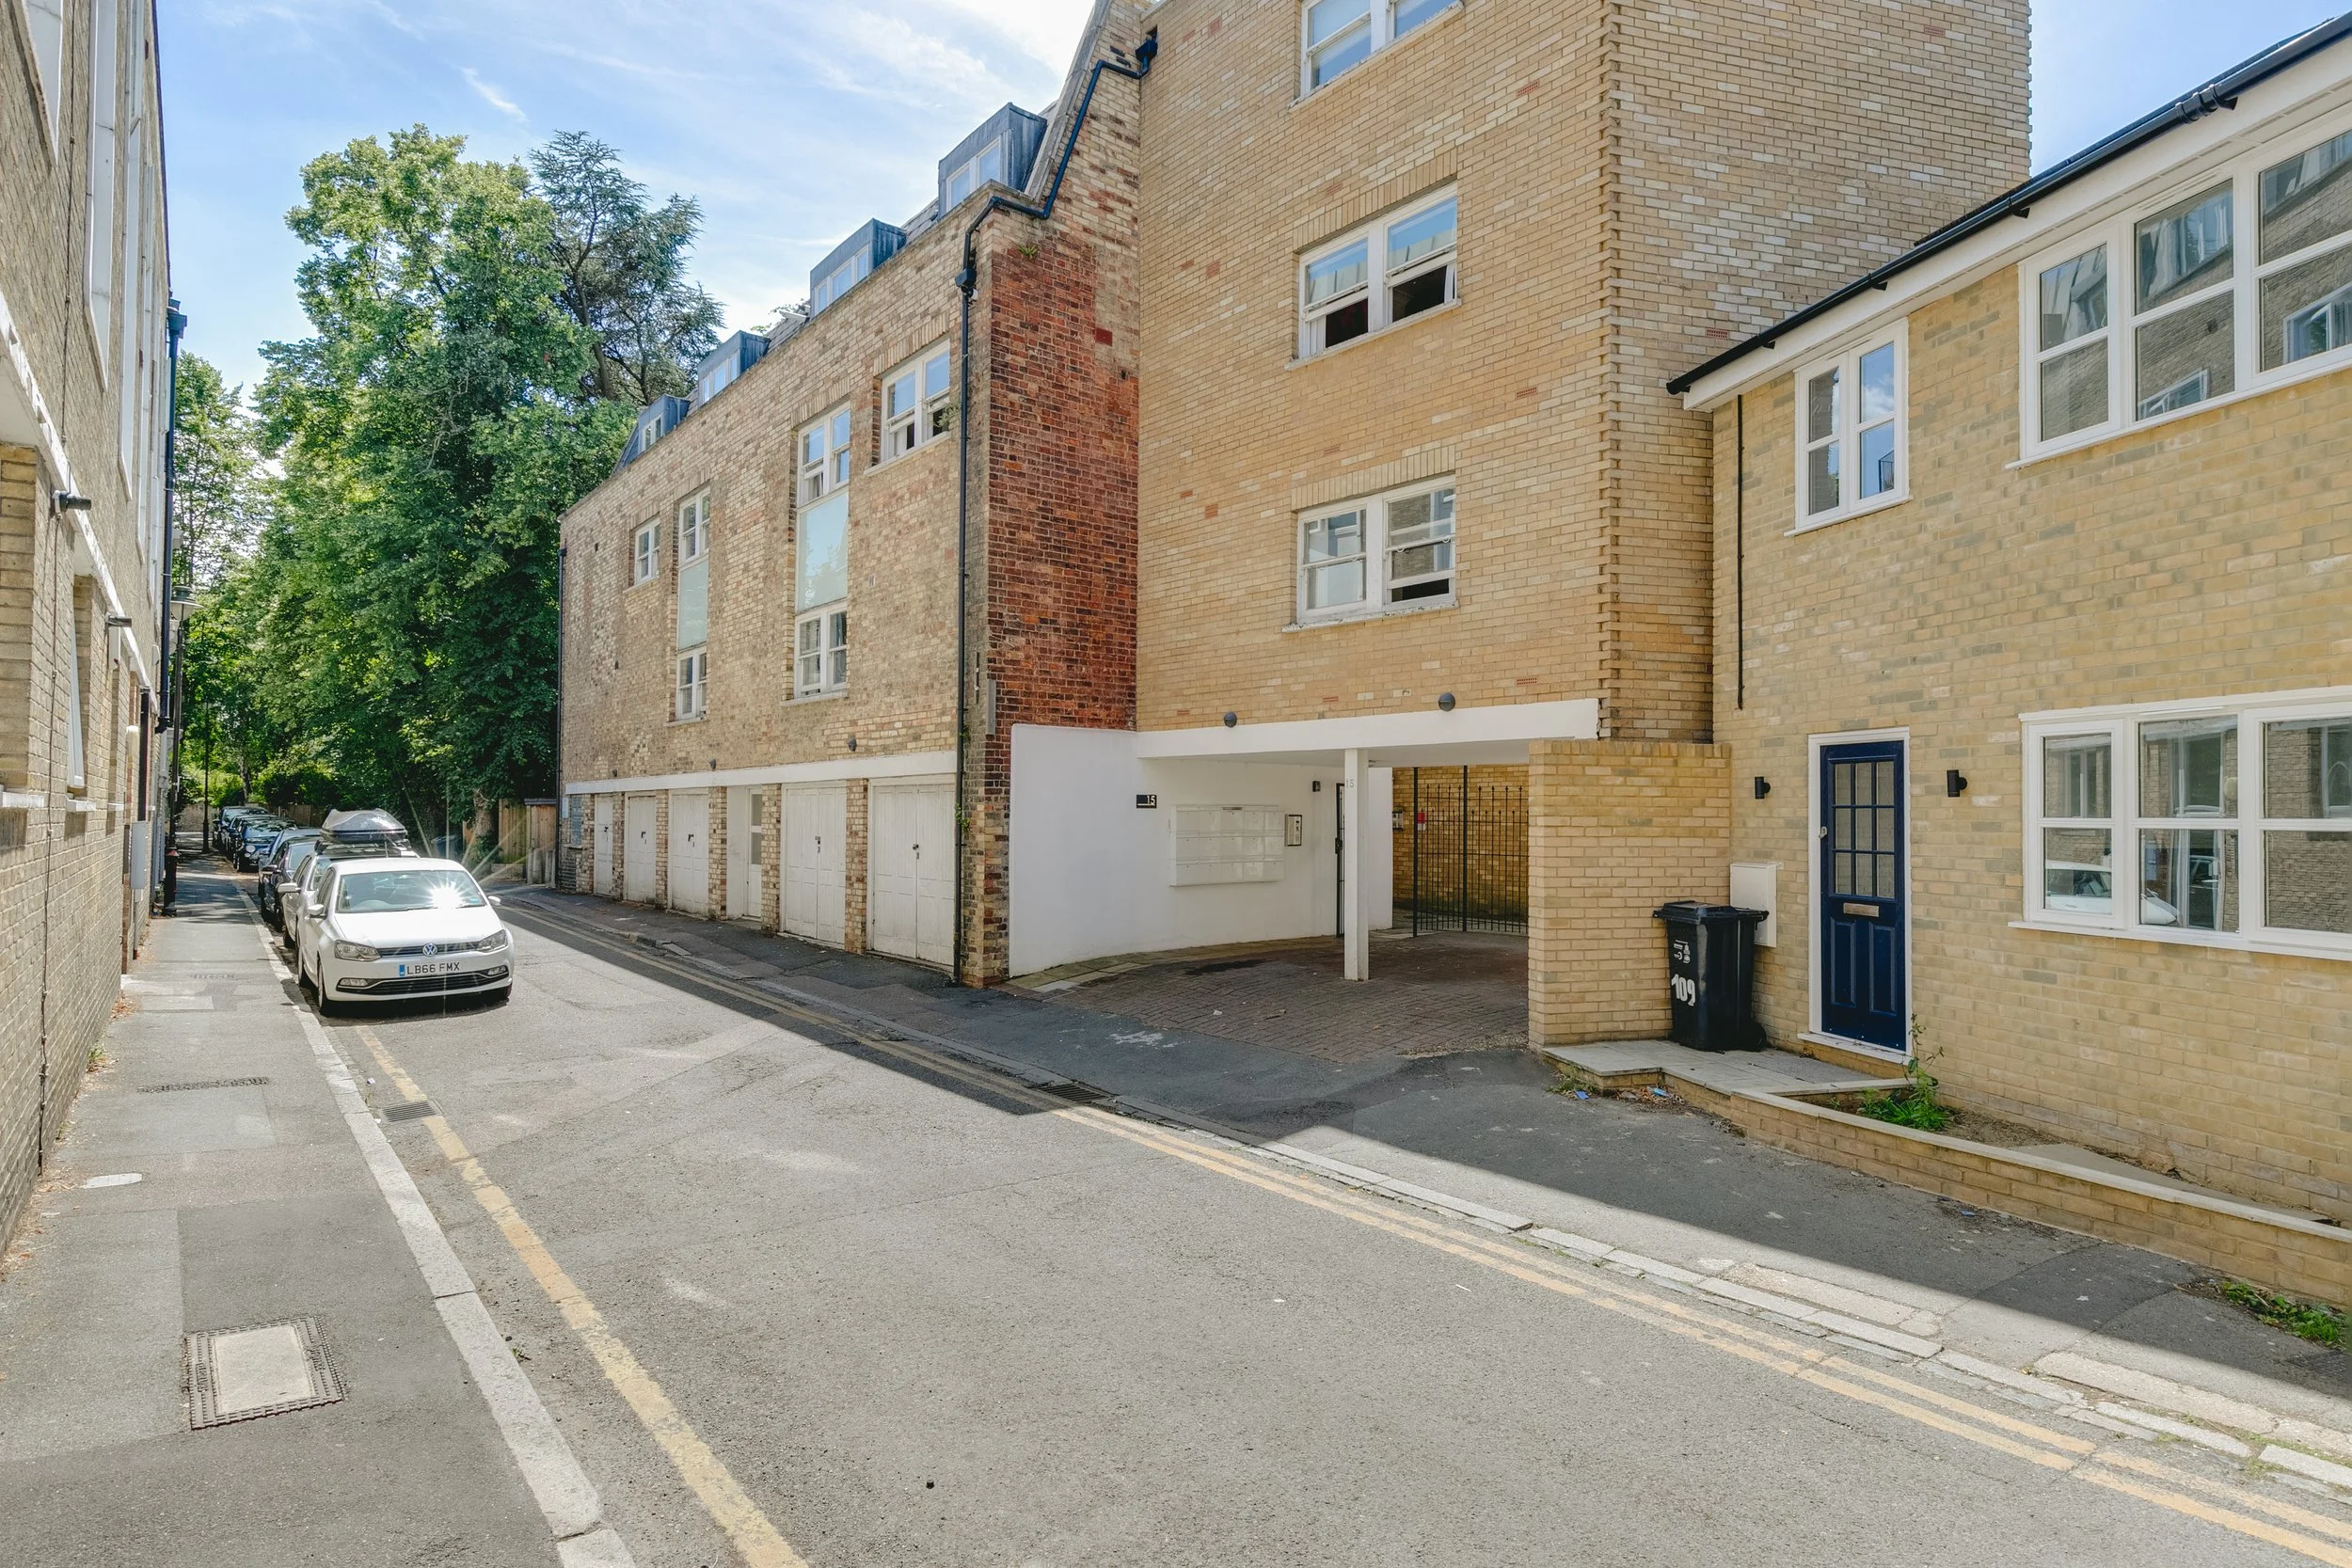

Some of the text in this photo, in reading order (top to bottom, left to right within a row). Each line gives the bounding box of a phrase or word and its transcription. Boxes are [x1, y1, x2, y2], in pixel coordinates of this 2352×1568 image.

[1345, 778, 1355, 788] 15
[1146, 795, 1155, 805] 15
[406, 961, 460, 975] LB66 FMX
[1671, 974, 1696, 1006] 109
